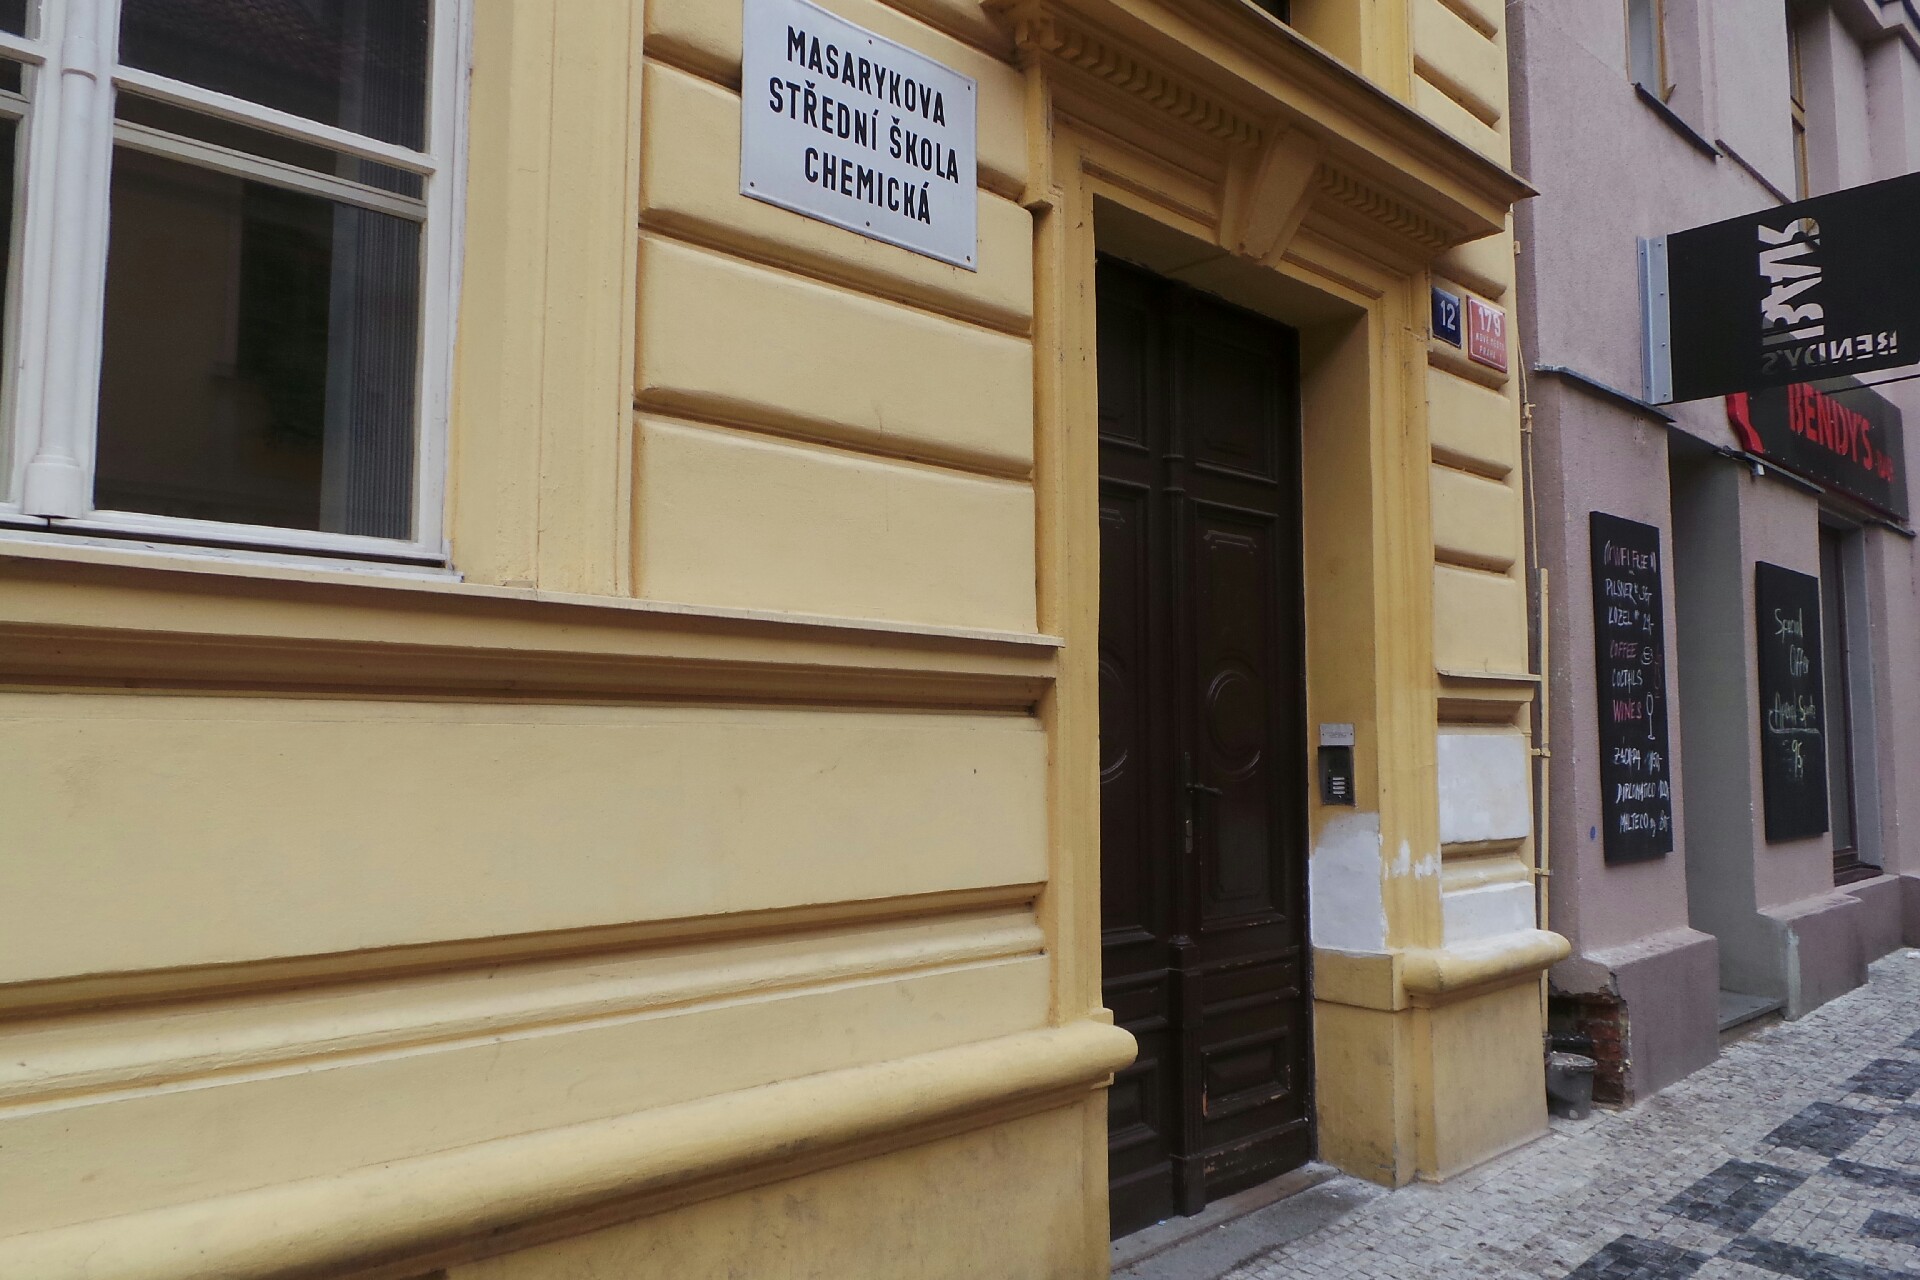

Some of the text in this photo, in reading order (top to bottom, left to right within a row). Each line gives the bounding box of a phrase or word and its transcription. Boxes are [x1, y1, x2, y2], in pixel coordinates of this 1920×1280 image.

[787, 25, 946, 127] MASARYKOVA
[769, 76, 959, 184] STŘEDNÍ ŠKOLA
[804, 147, 931, 225] CHEMICKÁ
[1440, 300, 1456, 331] 12
[1478, 306, 1501, 337] 179
[1609, 640, 1639, 658] COFFEE
[1613, 699, 1642, 722] WINES
